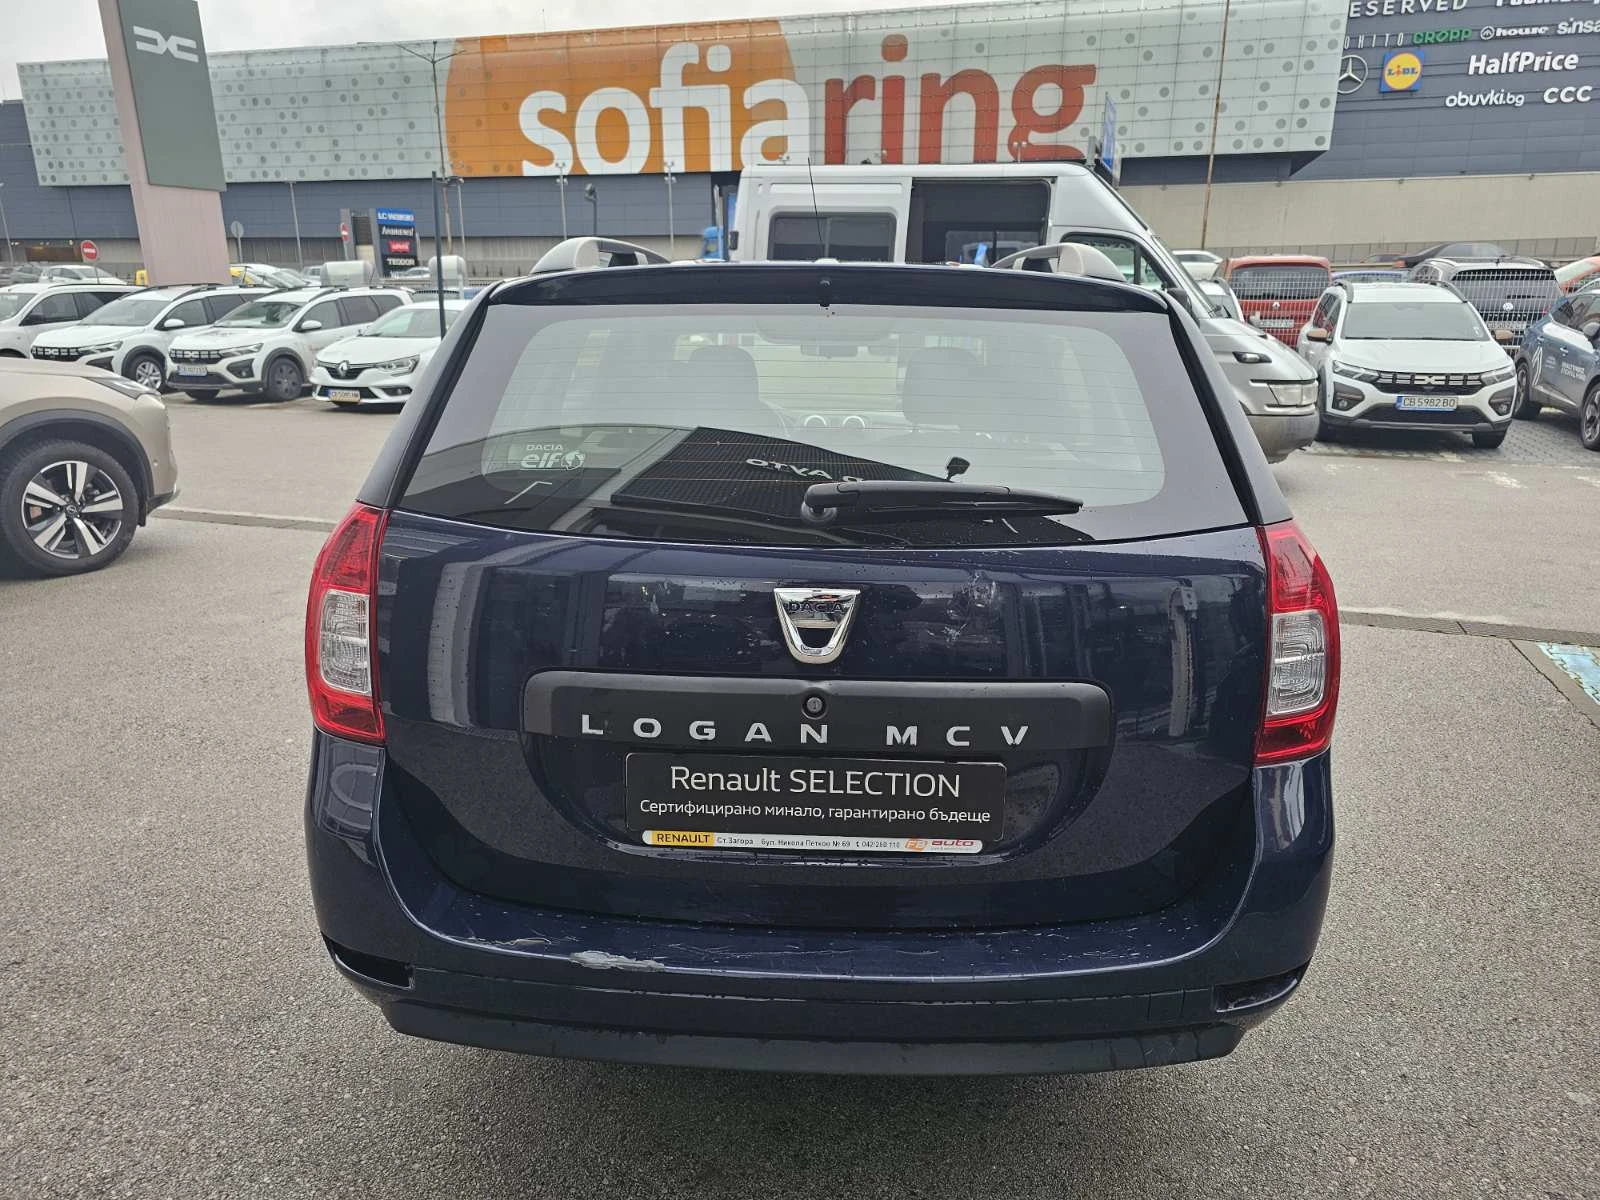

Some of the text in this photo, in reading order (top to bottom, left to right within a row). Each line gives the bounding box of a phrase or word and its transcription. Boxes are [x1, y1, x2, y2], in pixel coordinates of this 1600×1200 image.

[1468, 51, 1579, 76] HalfPrice
[1445, 89, 1525, 107] obuvki.bg
[1543, 85, 1593, 104] CCC
[520, 452, 563, 468] elf
[788, 600, 845, 613] DACIA
[581, 714, 1029, 746] LOGAN MCV
[670, 766, 960, 798] Renault SELECTION
[639, 798, 991, 824] Сертифицирано минало, гарантирано бъдеще
[656, 833, 711, 844] RENAULT
